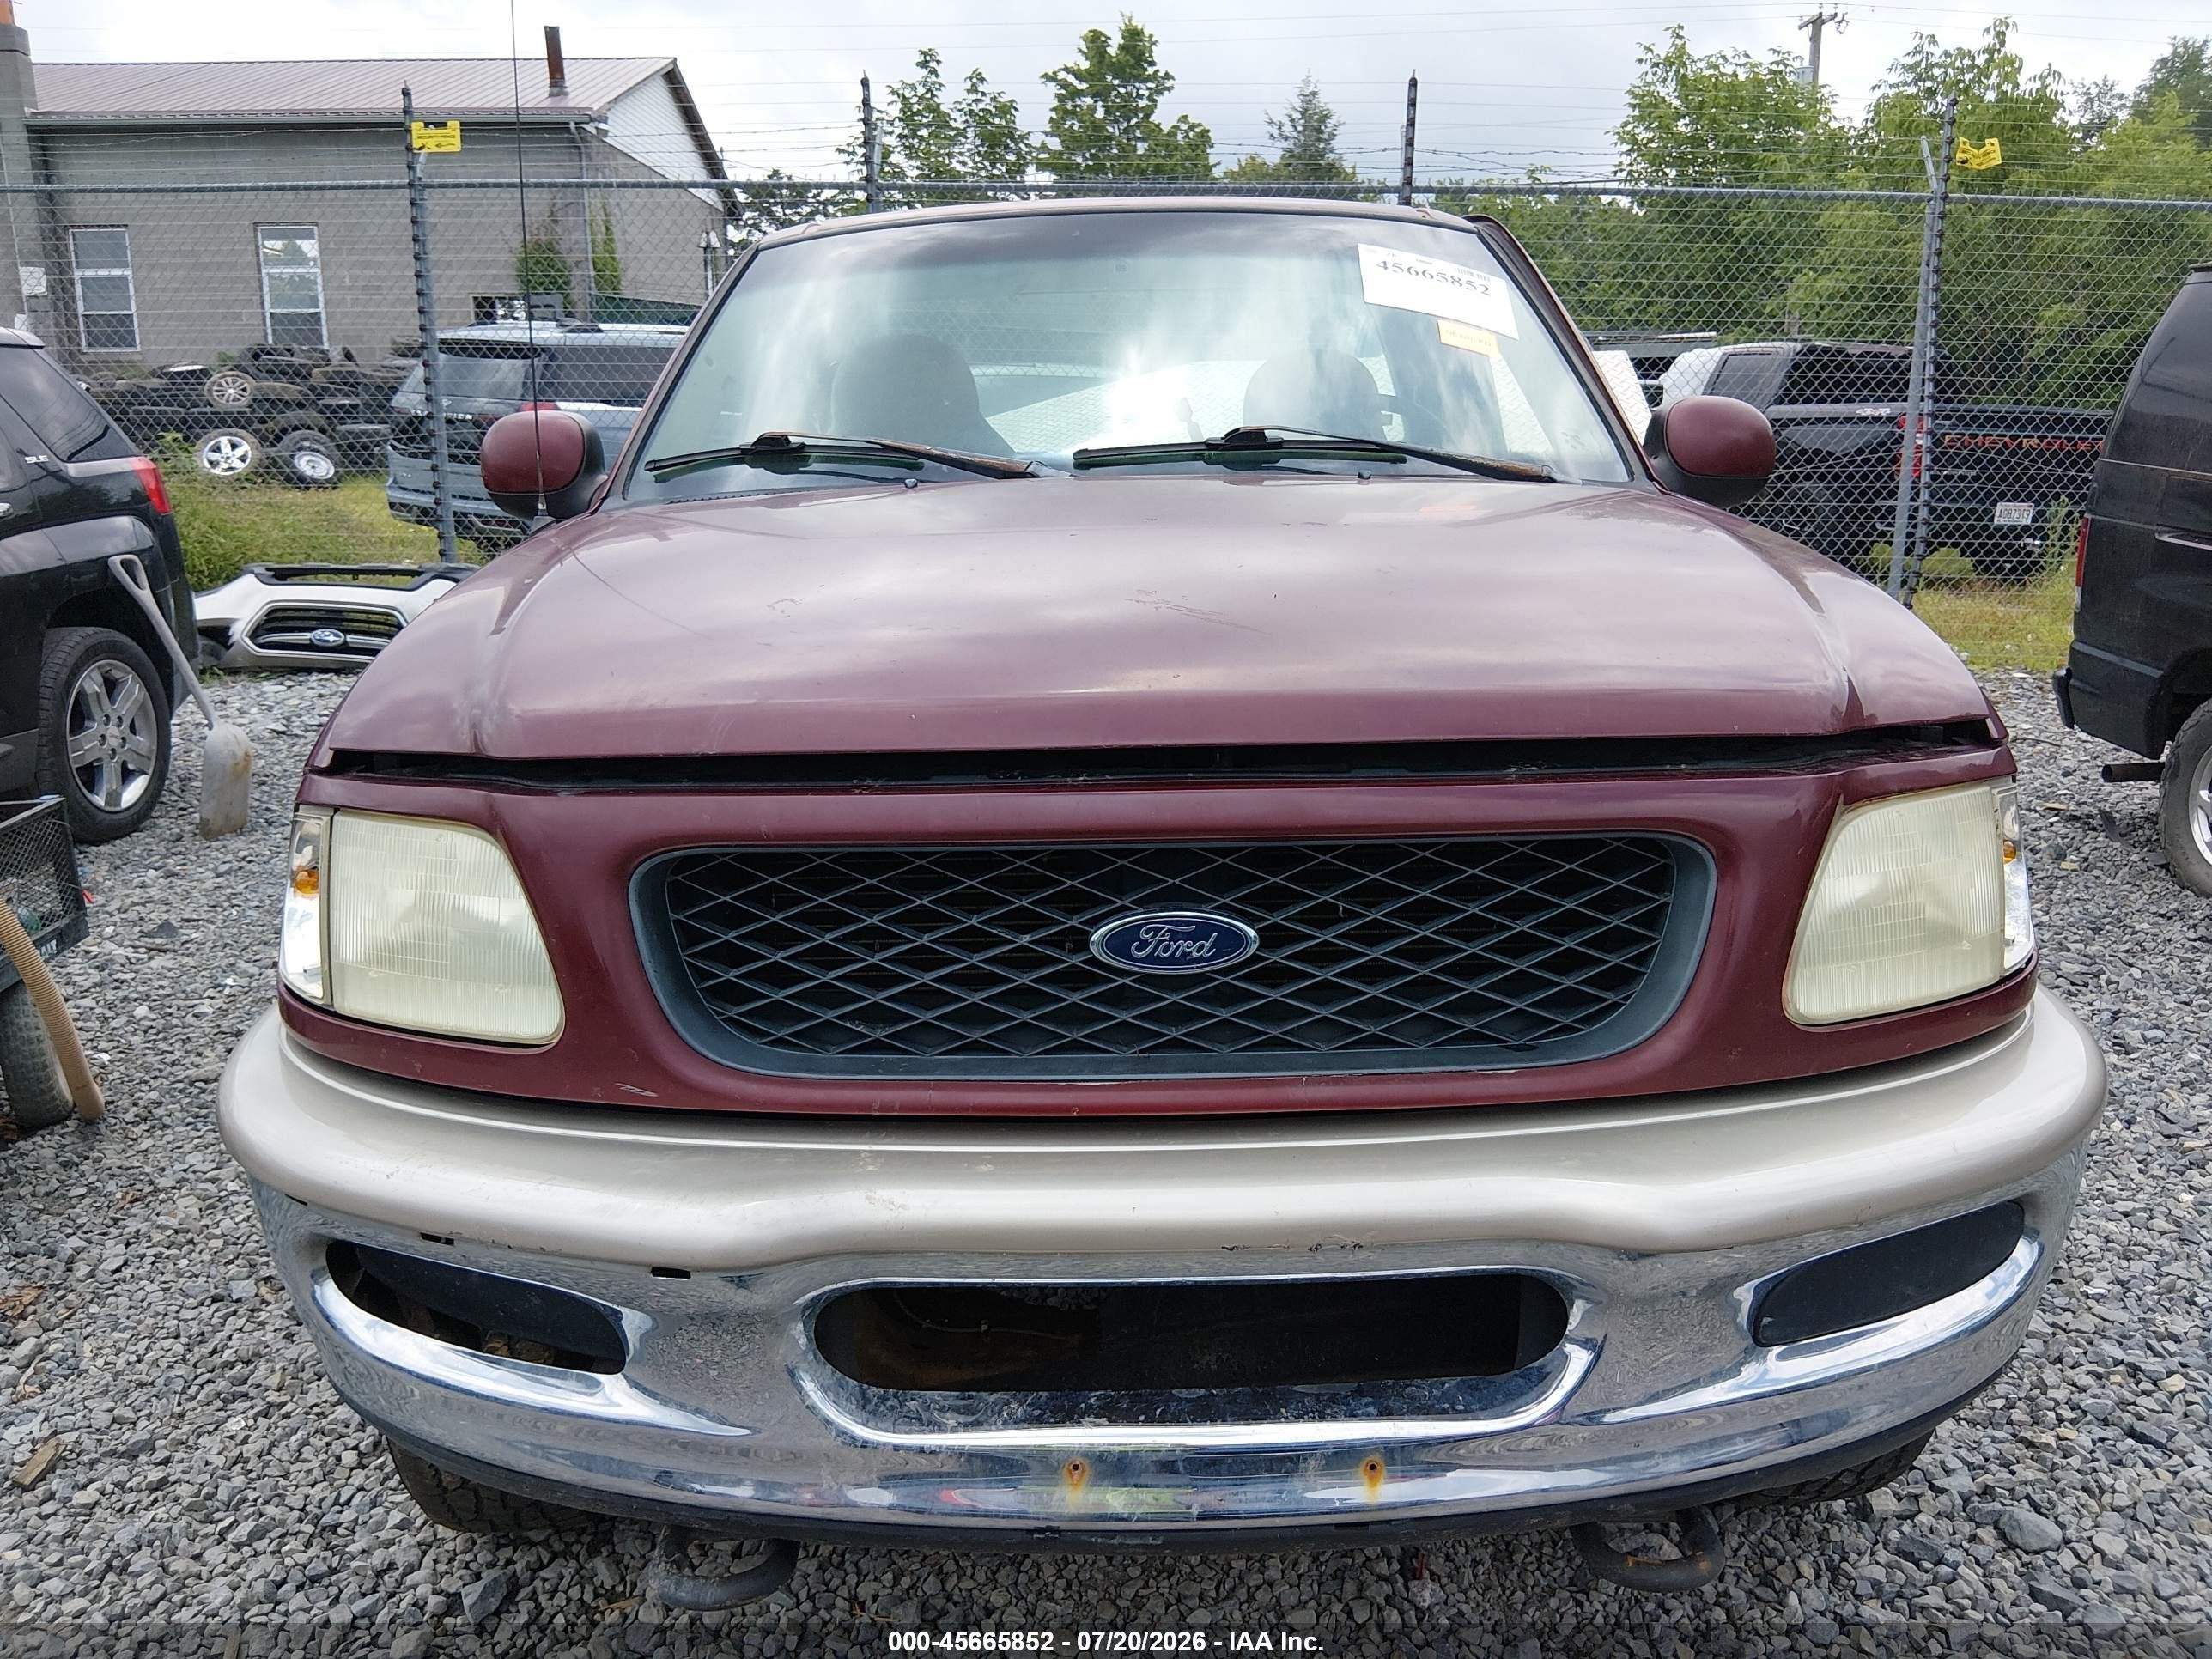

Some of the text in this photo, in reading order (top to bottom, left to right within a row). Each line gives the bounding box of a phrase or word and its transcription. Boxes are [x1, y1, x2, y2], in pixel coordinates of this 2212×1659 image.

[1376, 260, 1492, 296] 45665852
[24, 455, 49, 464] SLE
[1130, 923, 1218, 959] Ford
